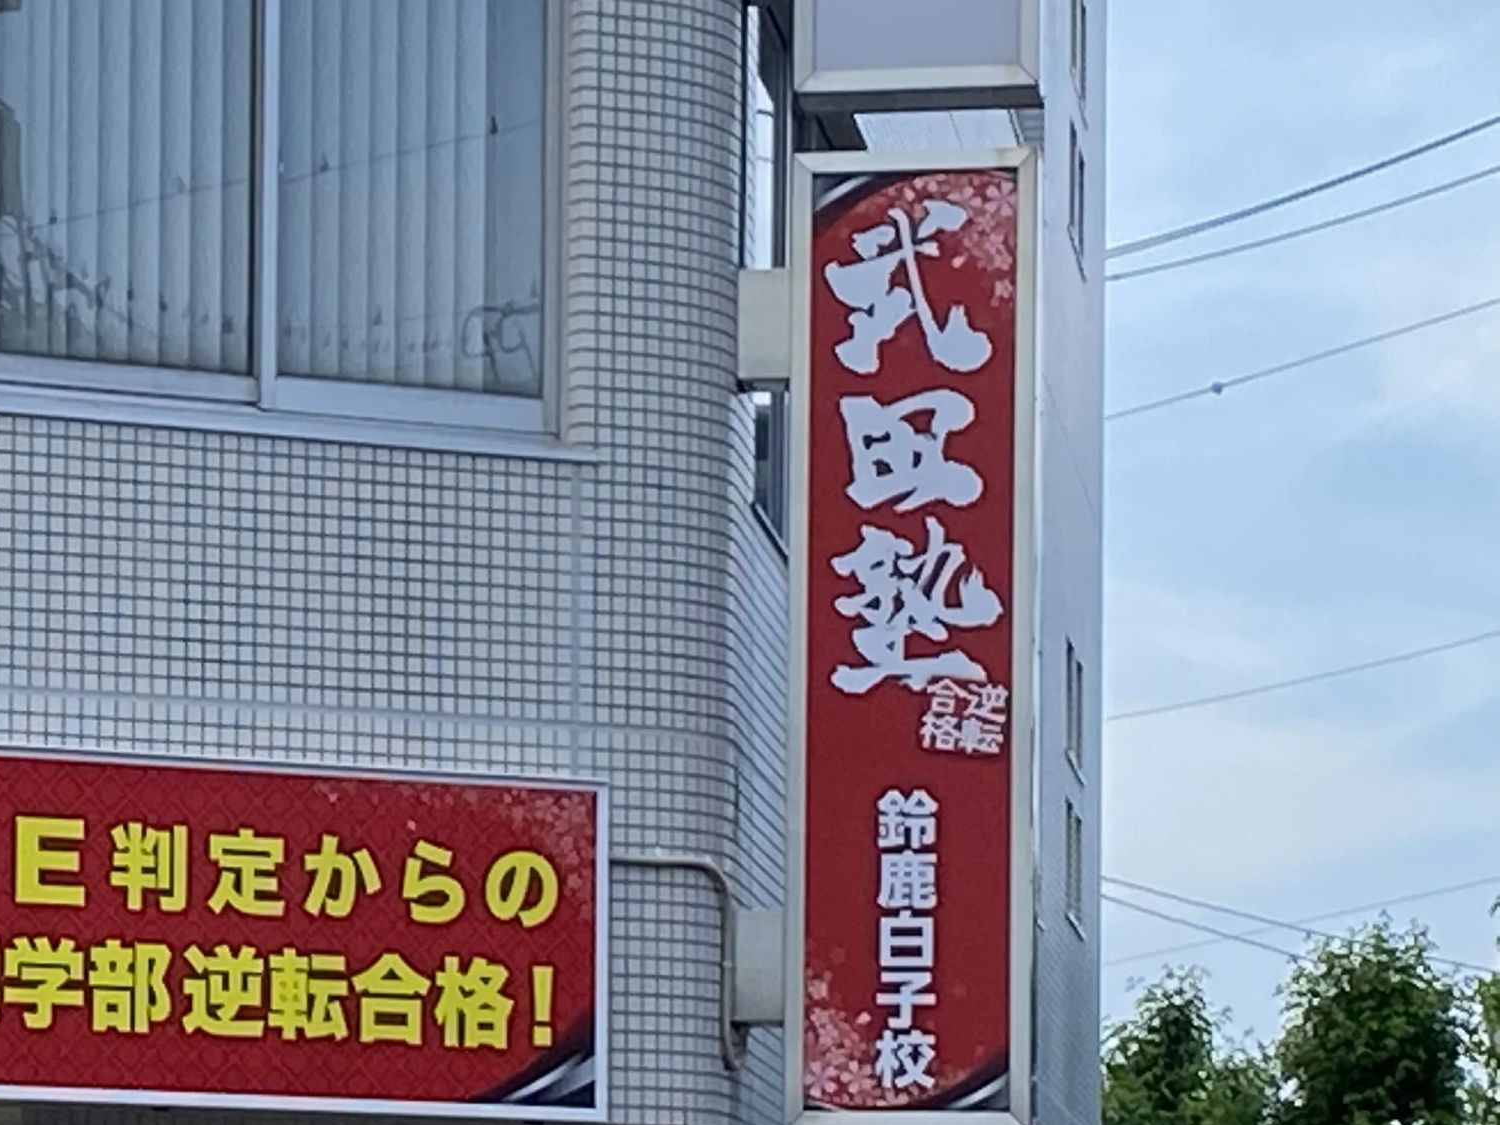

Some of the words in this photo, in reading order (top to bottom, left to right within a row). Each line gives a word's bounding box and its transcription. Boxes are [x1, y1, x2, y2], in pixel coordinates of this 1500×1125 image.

[823, 199, 1004, 694] 武田塾
[875, 789, 939, 1090] 鈴鹿白子校
